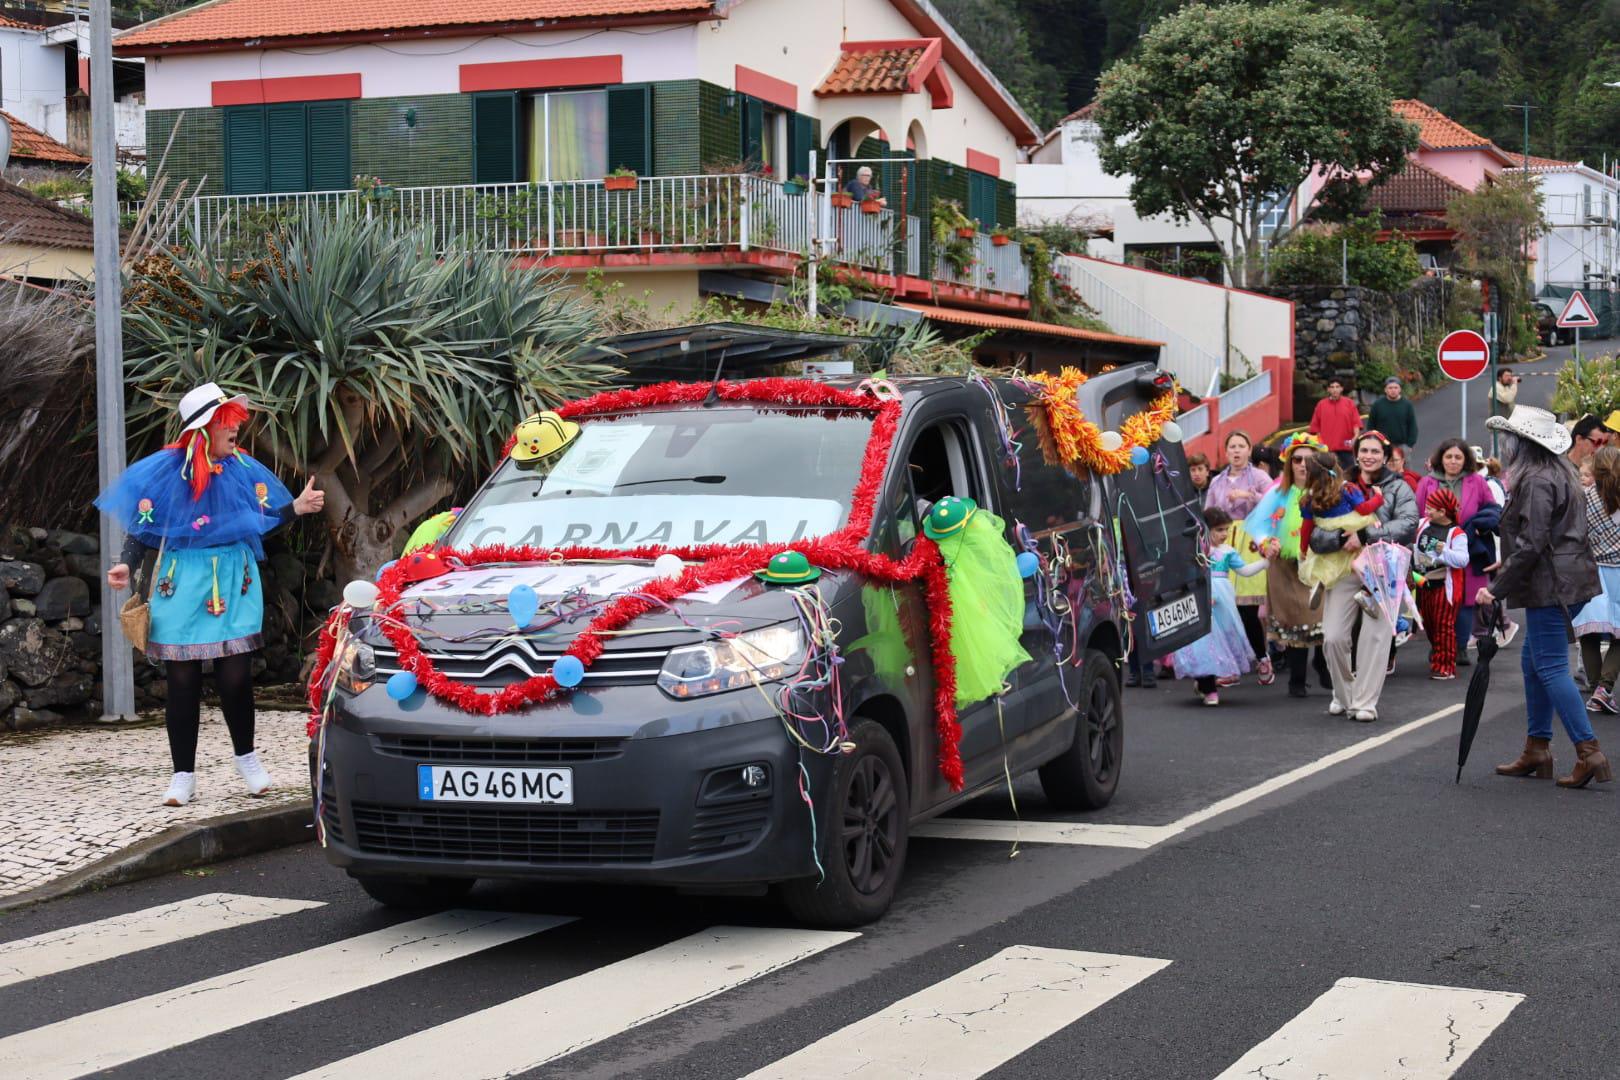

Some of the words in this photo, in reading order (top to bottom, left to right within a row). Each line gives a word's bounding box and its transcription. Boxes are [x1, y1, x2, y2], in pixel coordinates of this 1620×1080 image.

[422, 573, 708, 594] SEIX
[1158, 597, 1196, 630] AG46MC
[440, 770, 564, 800] AG46MC
